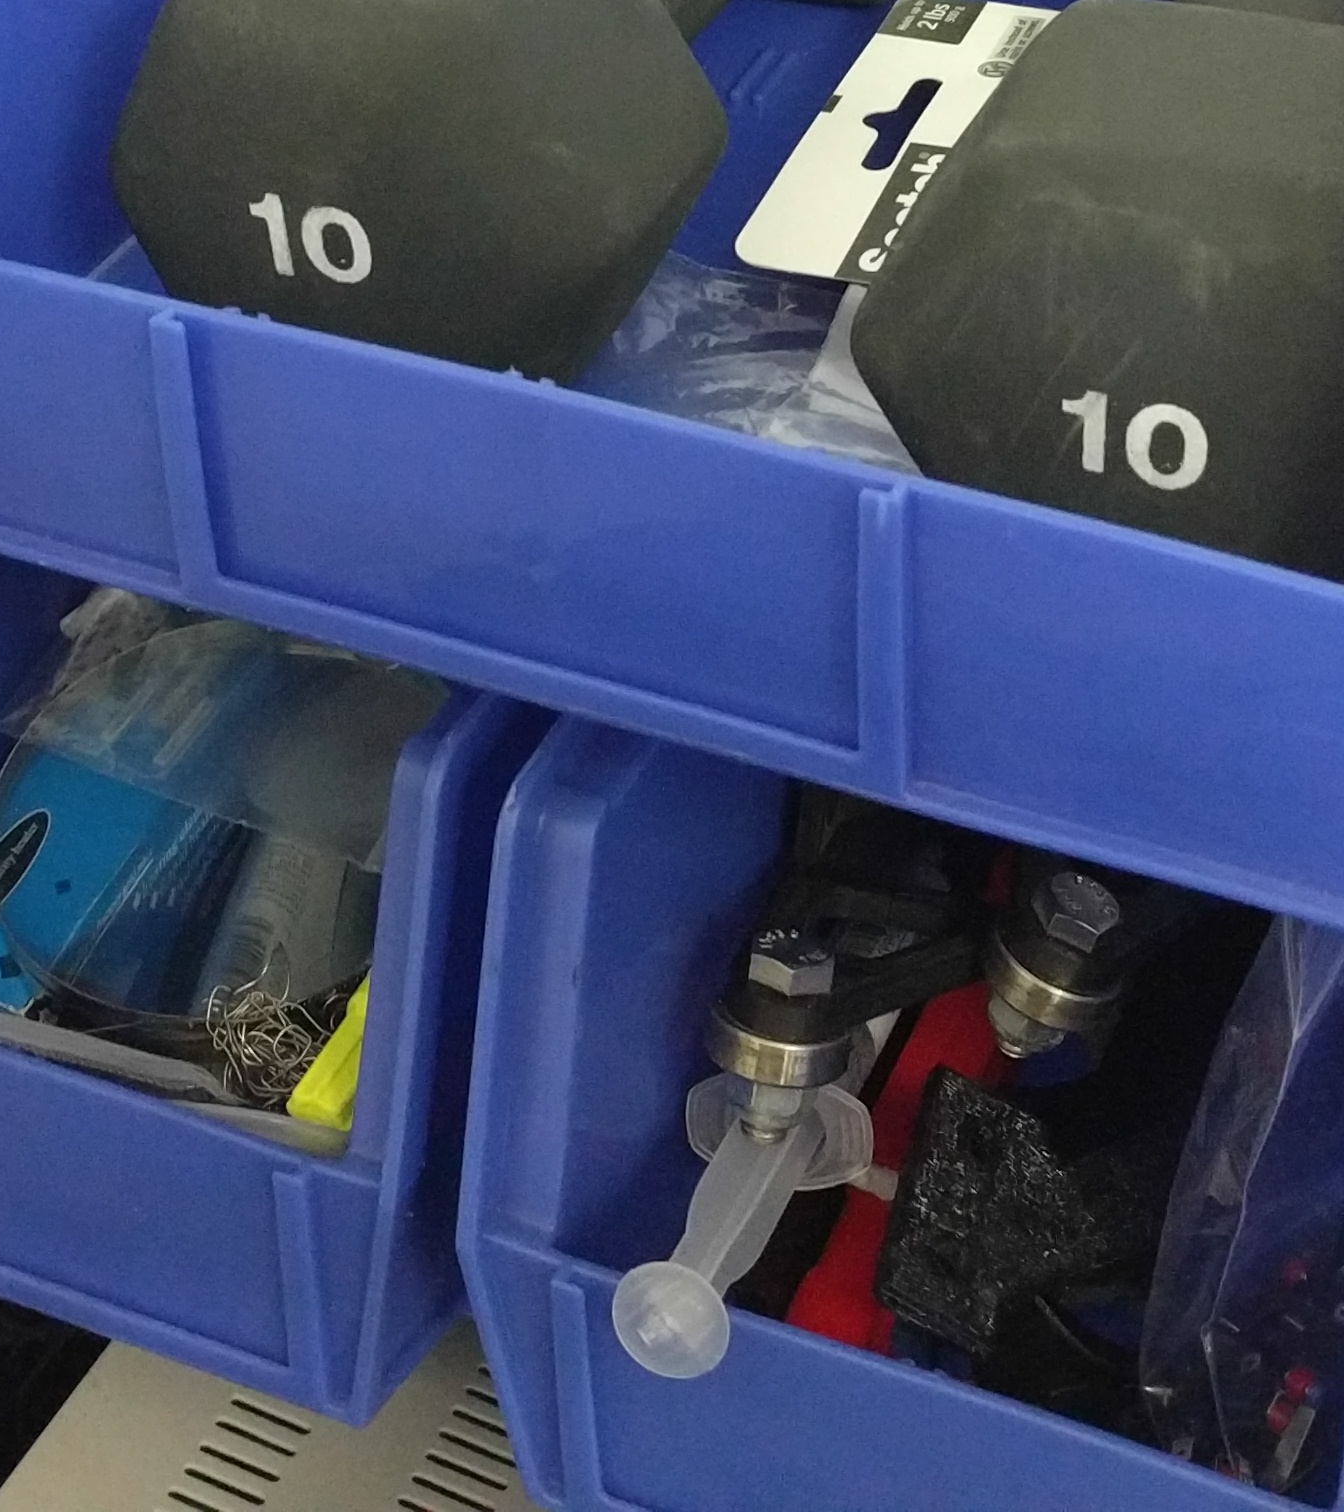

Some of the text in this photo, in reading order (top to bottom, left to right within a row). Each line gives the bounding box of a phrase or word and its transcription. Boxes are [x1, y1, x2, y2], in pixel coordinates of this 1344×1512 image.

[917, 2, 951, 31] 2 lbs
[249, 192, 372, 284] 10
[1061, 389, 1208, 490] 10
